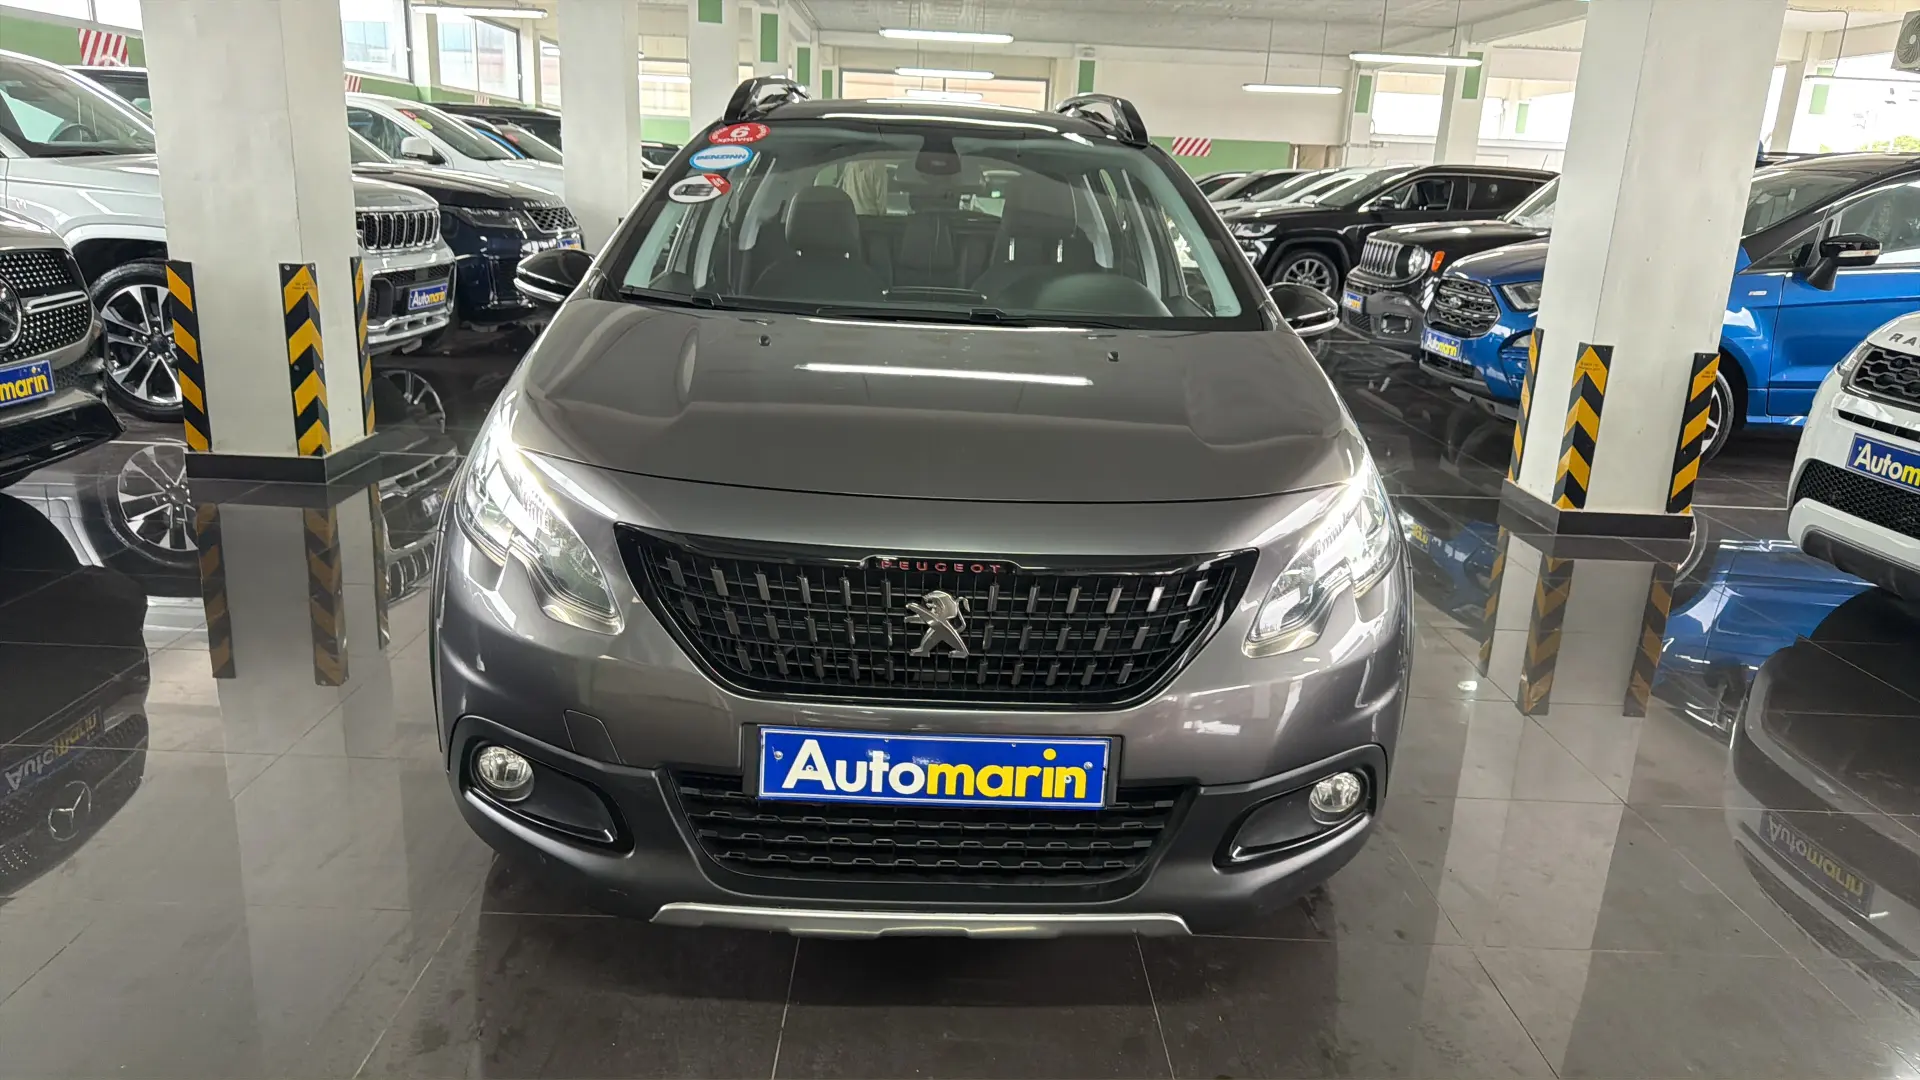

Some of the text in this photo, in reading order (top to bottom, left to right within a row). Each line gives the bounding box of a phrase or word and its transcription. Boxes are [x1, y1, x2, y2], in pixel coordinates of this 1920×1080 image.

[730, 127, 750, 138] 6
[1888, 333, 1920, 348] RA
[881, 560, 1000, 574] PEUGEOT
[782, 738, 1088, 799] Automarin
